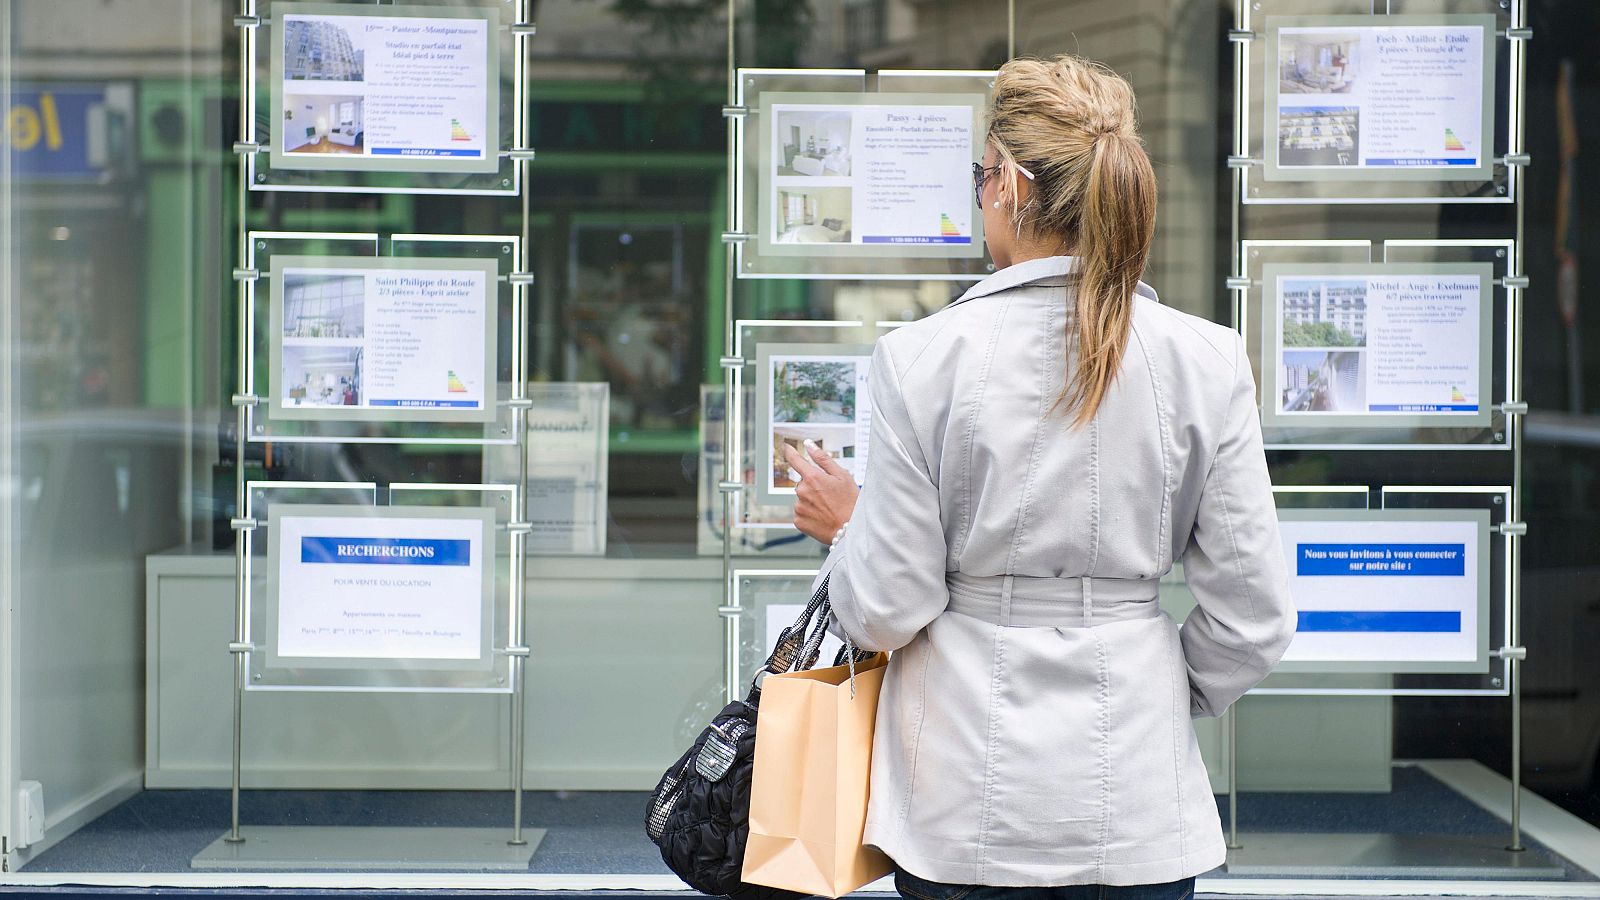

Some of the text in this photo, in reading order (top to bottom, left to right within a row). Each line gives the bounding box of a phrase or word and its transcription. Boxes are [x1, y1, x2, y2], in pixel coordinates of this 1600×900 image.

[1376, 35, 1397, 43] Foch
[1406, 35, 1436, 43] Maillot
[1445, 35, 1470, 43] Etoile
[421, 42, 446, 50] parfait
[1386, 46, 1408, 54] pièces
[1416, 46, 1446, 54] Triangle
[887, 114, 909, 122] Passy
[375, 278, 476, 288] Saint Philippe du Roule
[1408, 283, 1428, 291] Ange
[421, 289, 444, 298] Esprit
[1400, 293, 1421, 301] pièces
[337, 544, 434, 558] RECHERCHONS
[1305, 549, 1327, 559] Nous
[1350, 550, 1384, 559] invitons
[1386, 549, 1392, 559] à
[1415, 550, 1457, 559] connecter
[1349, 562, 1365, 570] sur
[1366, 562, 1389, 570] notre
[1390, 561, 1406, 570] site
